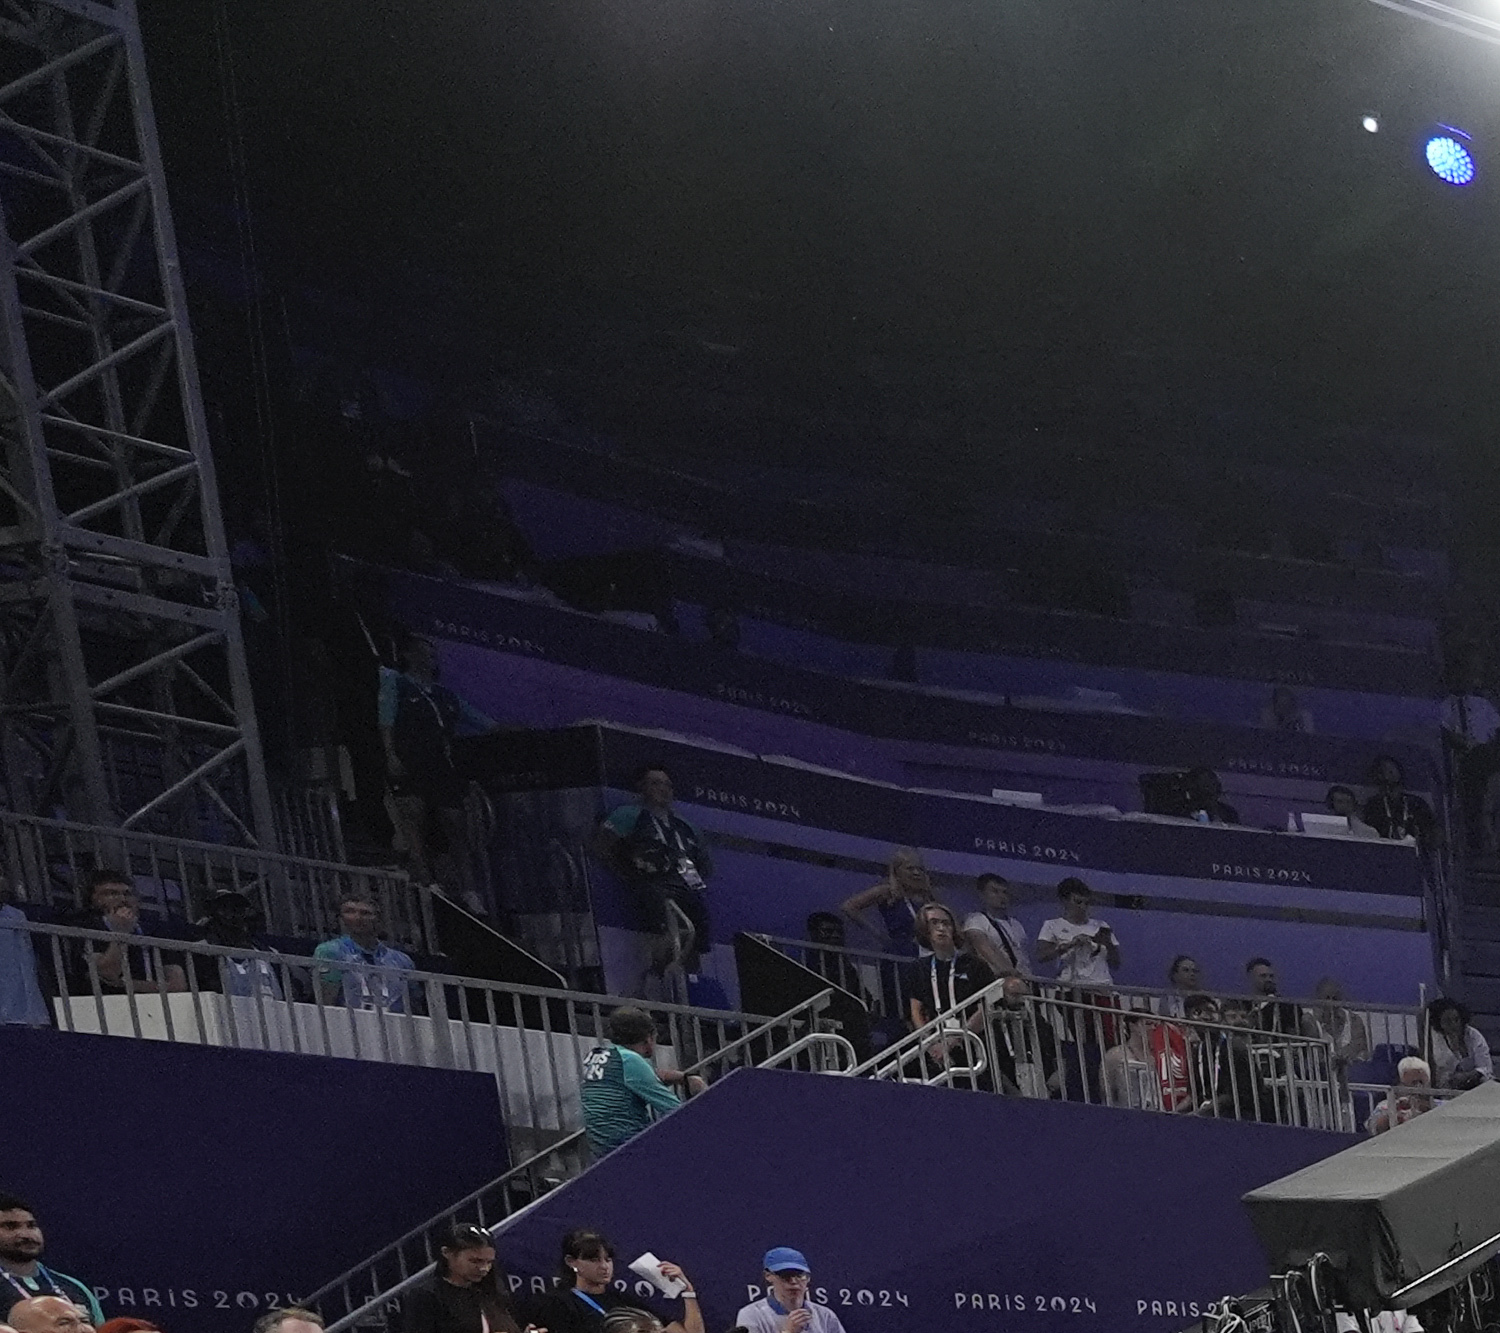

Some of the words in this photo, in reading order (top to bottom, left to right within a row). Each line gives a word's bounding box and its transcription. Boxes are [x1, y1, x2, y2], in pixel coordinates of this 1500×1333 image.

[695, 786, 748, 810] PARIS
[753, 797, 802, 818] 2024
[973, 837, 1028, 857] PARIS
[1033, 843, 1081, 862] 2024
[1211, 863, 1262, 881] PARIS
[1267, 868, 1313, 884] 2024
[94, 1286, 198, 1308] PARIS
[214, 1291, 303, 1309] 2024
[839, 1288, 909, 1308] 2024
[955, 1293, 1026, 1311] PARIS
[1035, 1296, 1097, 1313] 2024
[1137, 1299, 1199, 1318] PARIS
